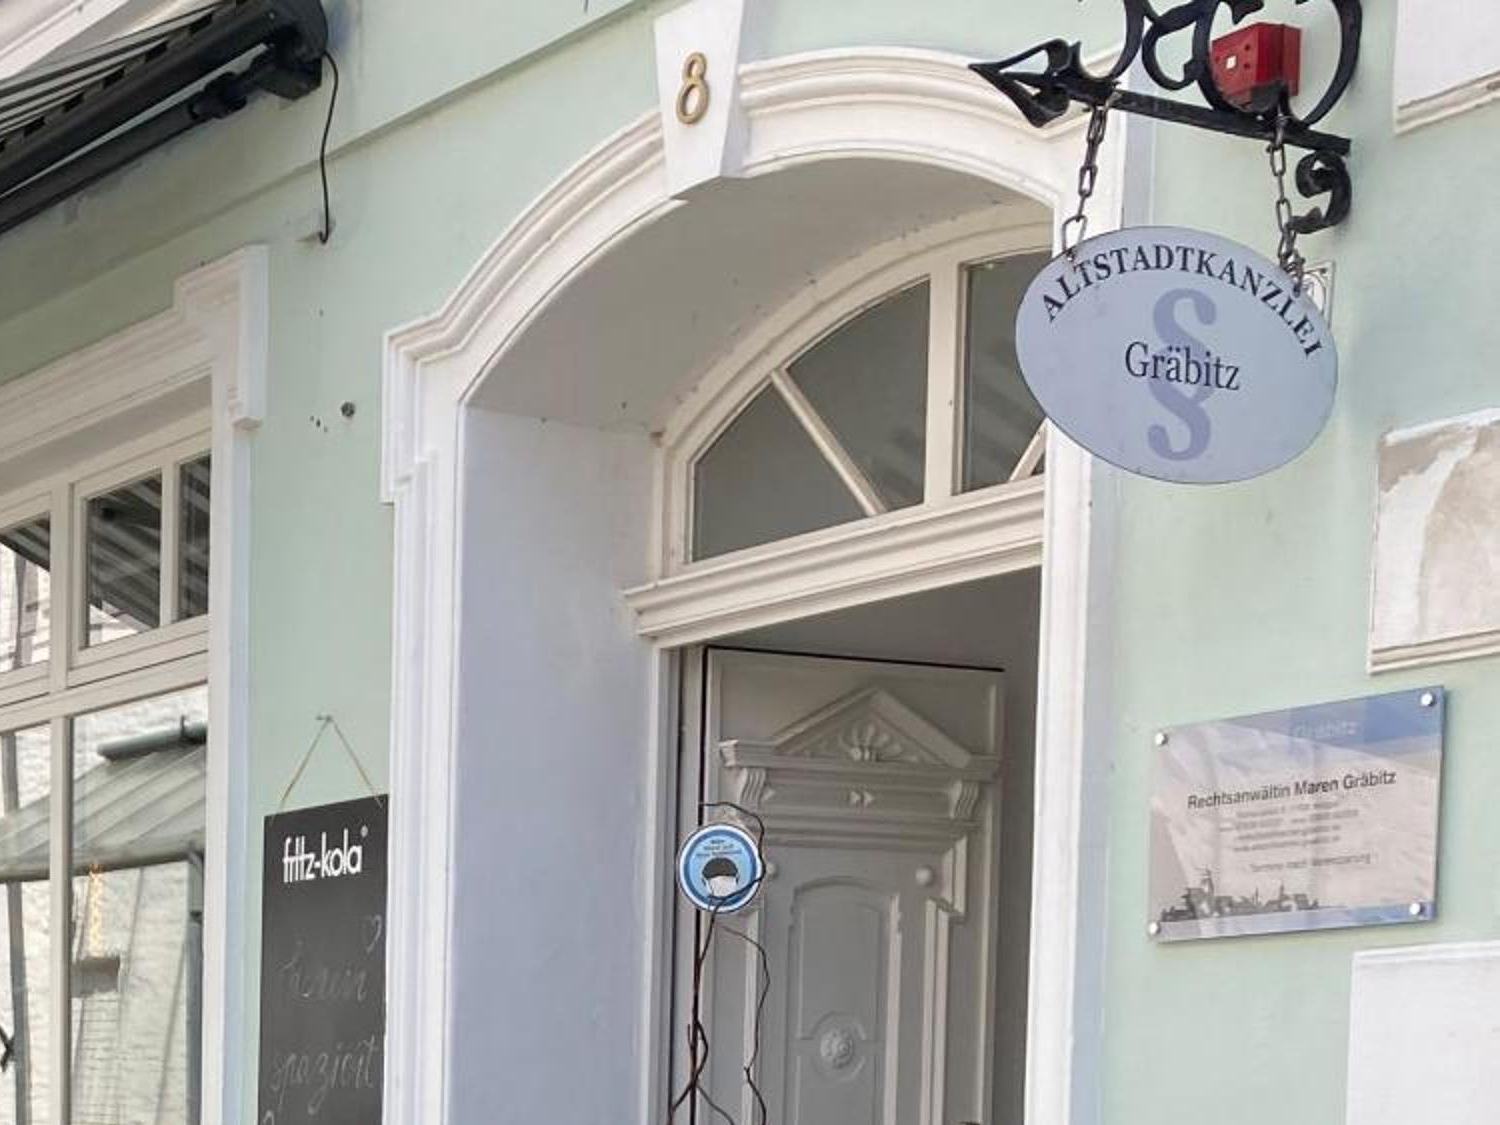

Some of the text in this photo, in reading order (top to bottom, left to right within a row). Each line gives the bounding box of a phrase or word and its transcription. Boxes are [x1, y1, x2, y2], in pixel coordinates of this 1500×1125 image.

[676, 52, 709, 125] 8
[1041, 243, 1325, 359] ALTSTADTKANZLEI
[1125, 341, 1241, 392] Gräbitz
[1187, 784, 1291, 809] Rechtsanwältin
[1294, 779, 1339, 796] Maren
[1343, 770, 1396, 790] Gräbitz
